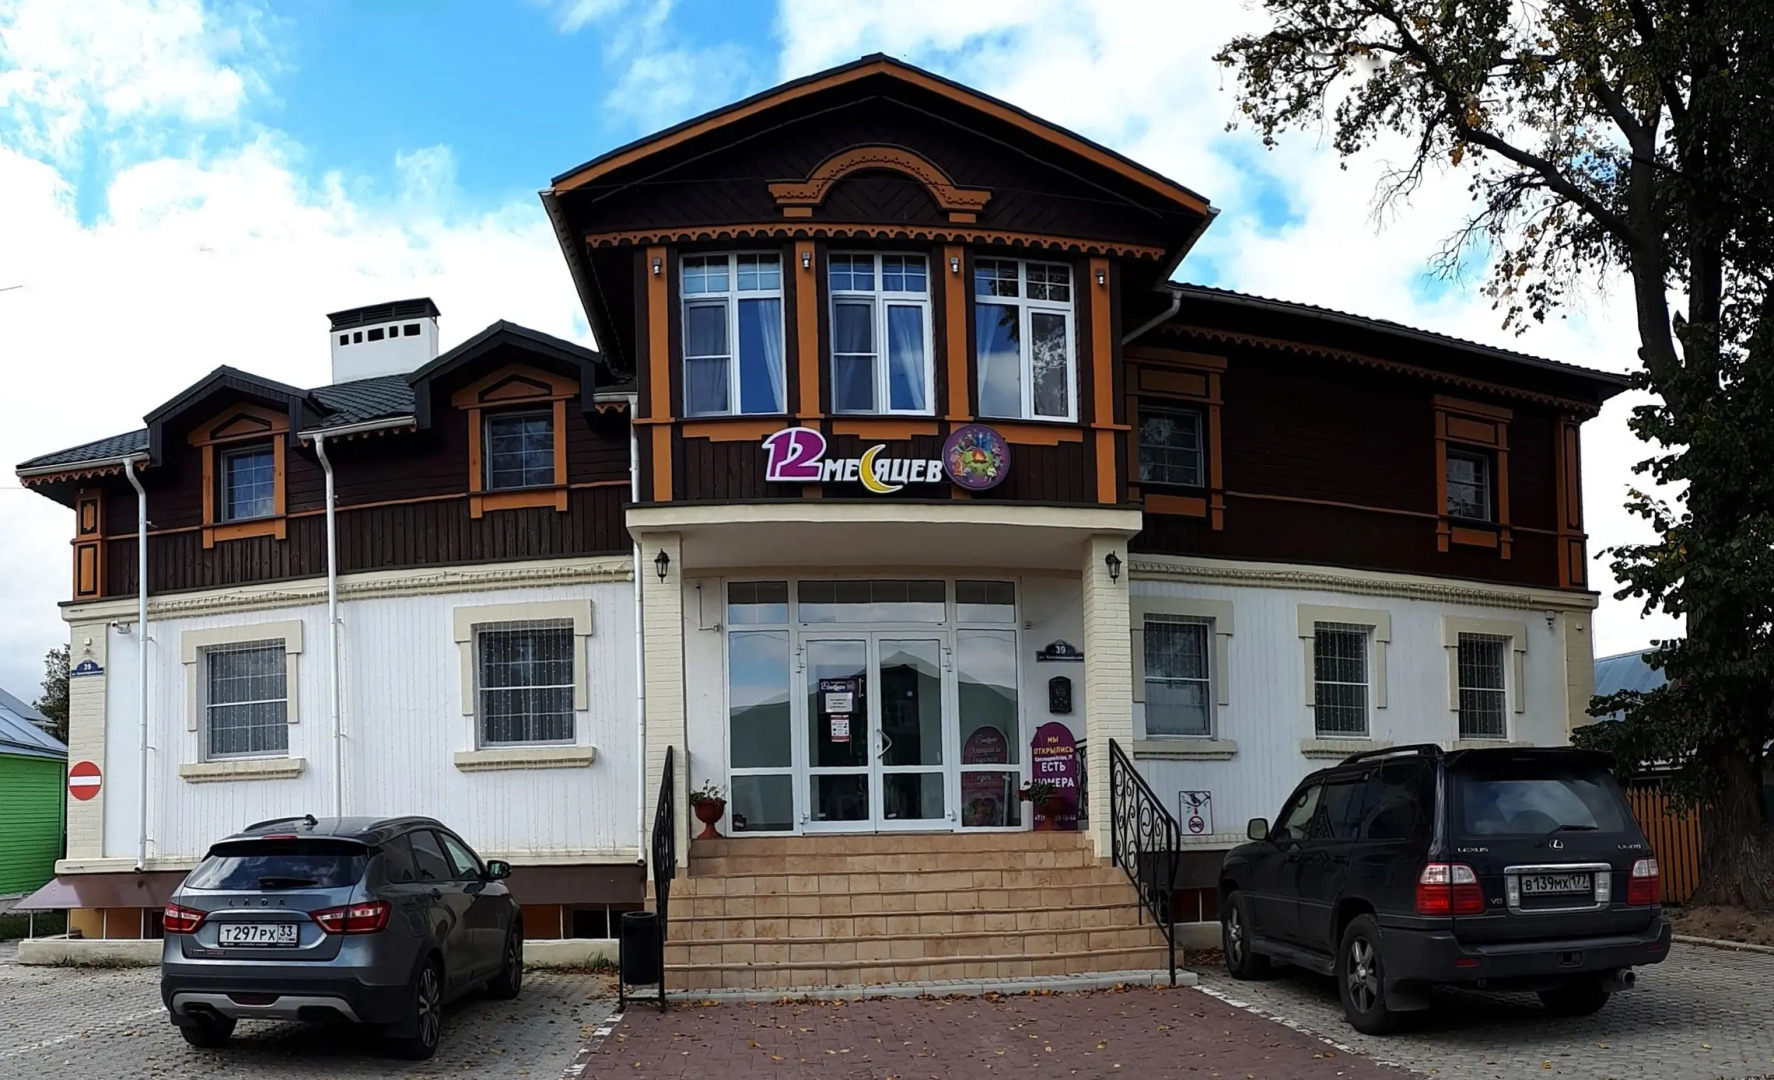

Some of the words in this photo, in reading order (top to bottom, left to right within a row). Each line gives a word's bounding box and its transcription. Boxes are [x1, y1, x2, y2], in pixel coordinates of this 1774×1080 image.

[762, 427, 827, 481] 12
[1055, 645, 1066, 654] 39
[83, 663, 92, 671] 39
[1033, 746, 1074, 755] ОТКРЫЛИСЬ
[1041, 761, 1066, 772] ЕСТЬ
[229, 898, 286, 907] LADA
[279, 925, 293, 937] 33
